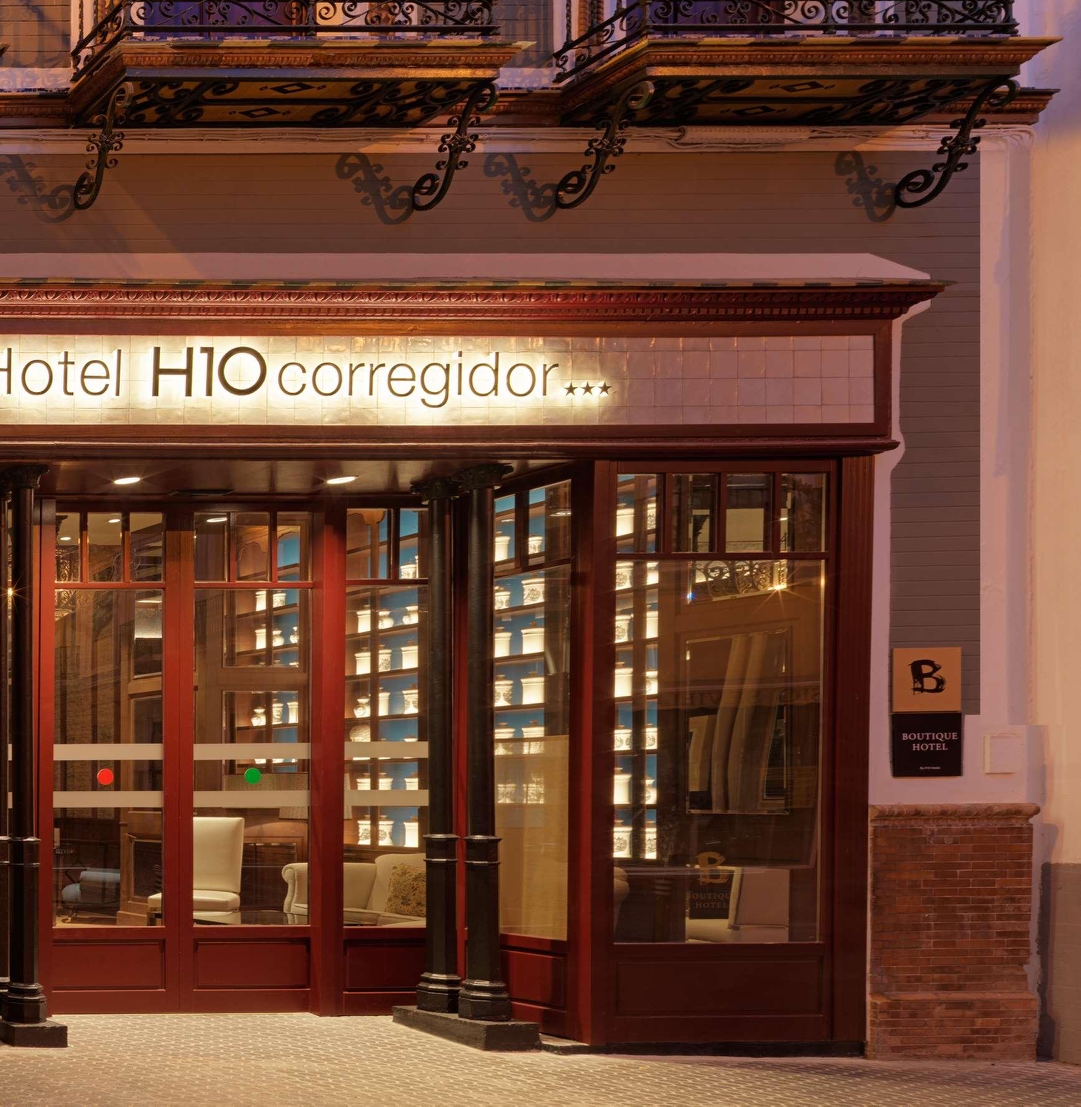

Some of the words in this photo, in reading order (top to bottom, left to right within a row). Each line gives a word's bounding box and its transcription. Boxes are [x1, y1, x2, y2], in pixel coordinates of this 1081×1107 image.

[151, 346, 268, 397] H10
[277, 350, 559, 409] corregidor
[908, 659, 947, 695] B
[902, 732, 959, 741] BOUTIQUE
[912, 743, 949, 751] HOTEL
[695, 852, 730, 885] B
